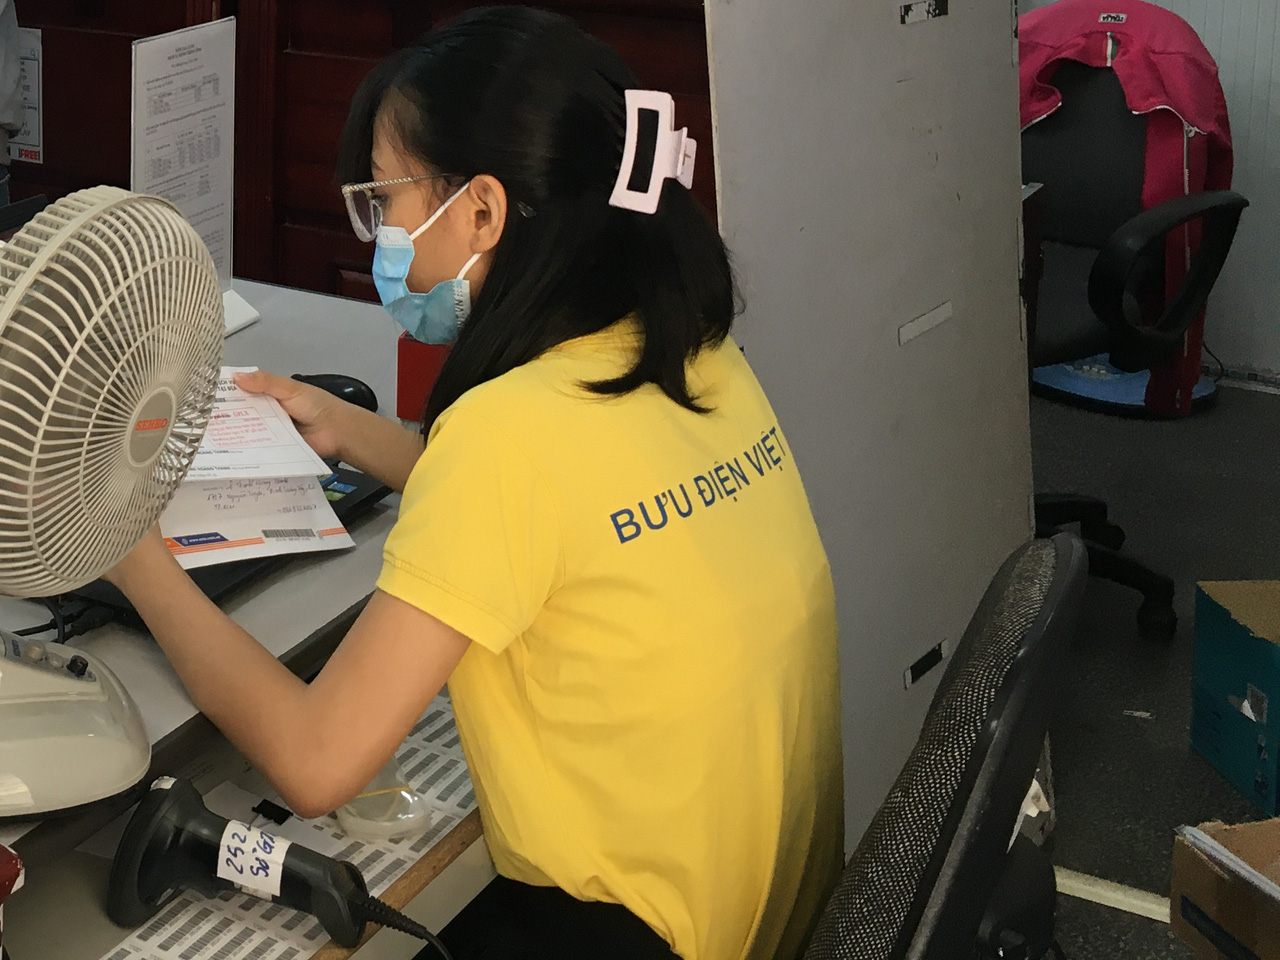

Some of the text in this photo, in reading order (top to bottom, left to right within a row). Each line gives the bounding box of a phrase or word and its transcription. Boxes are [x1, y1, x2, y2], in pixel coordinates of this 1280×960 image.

[610, 426, 786, 544] BƯU ĐIỆN VIỆT
